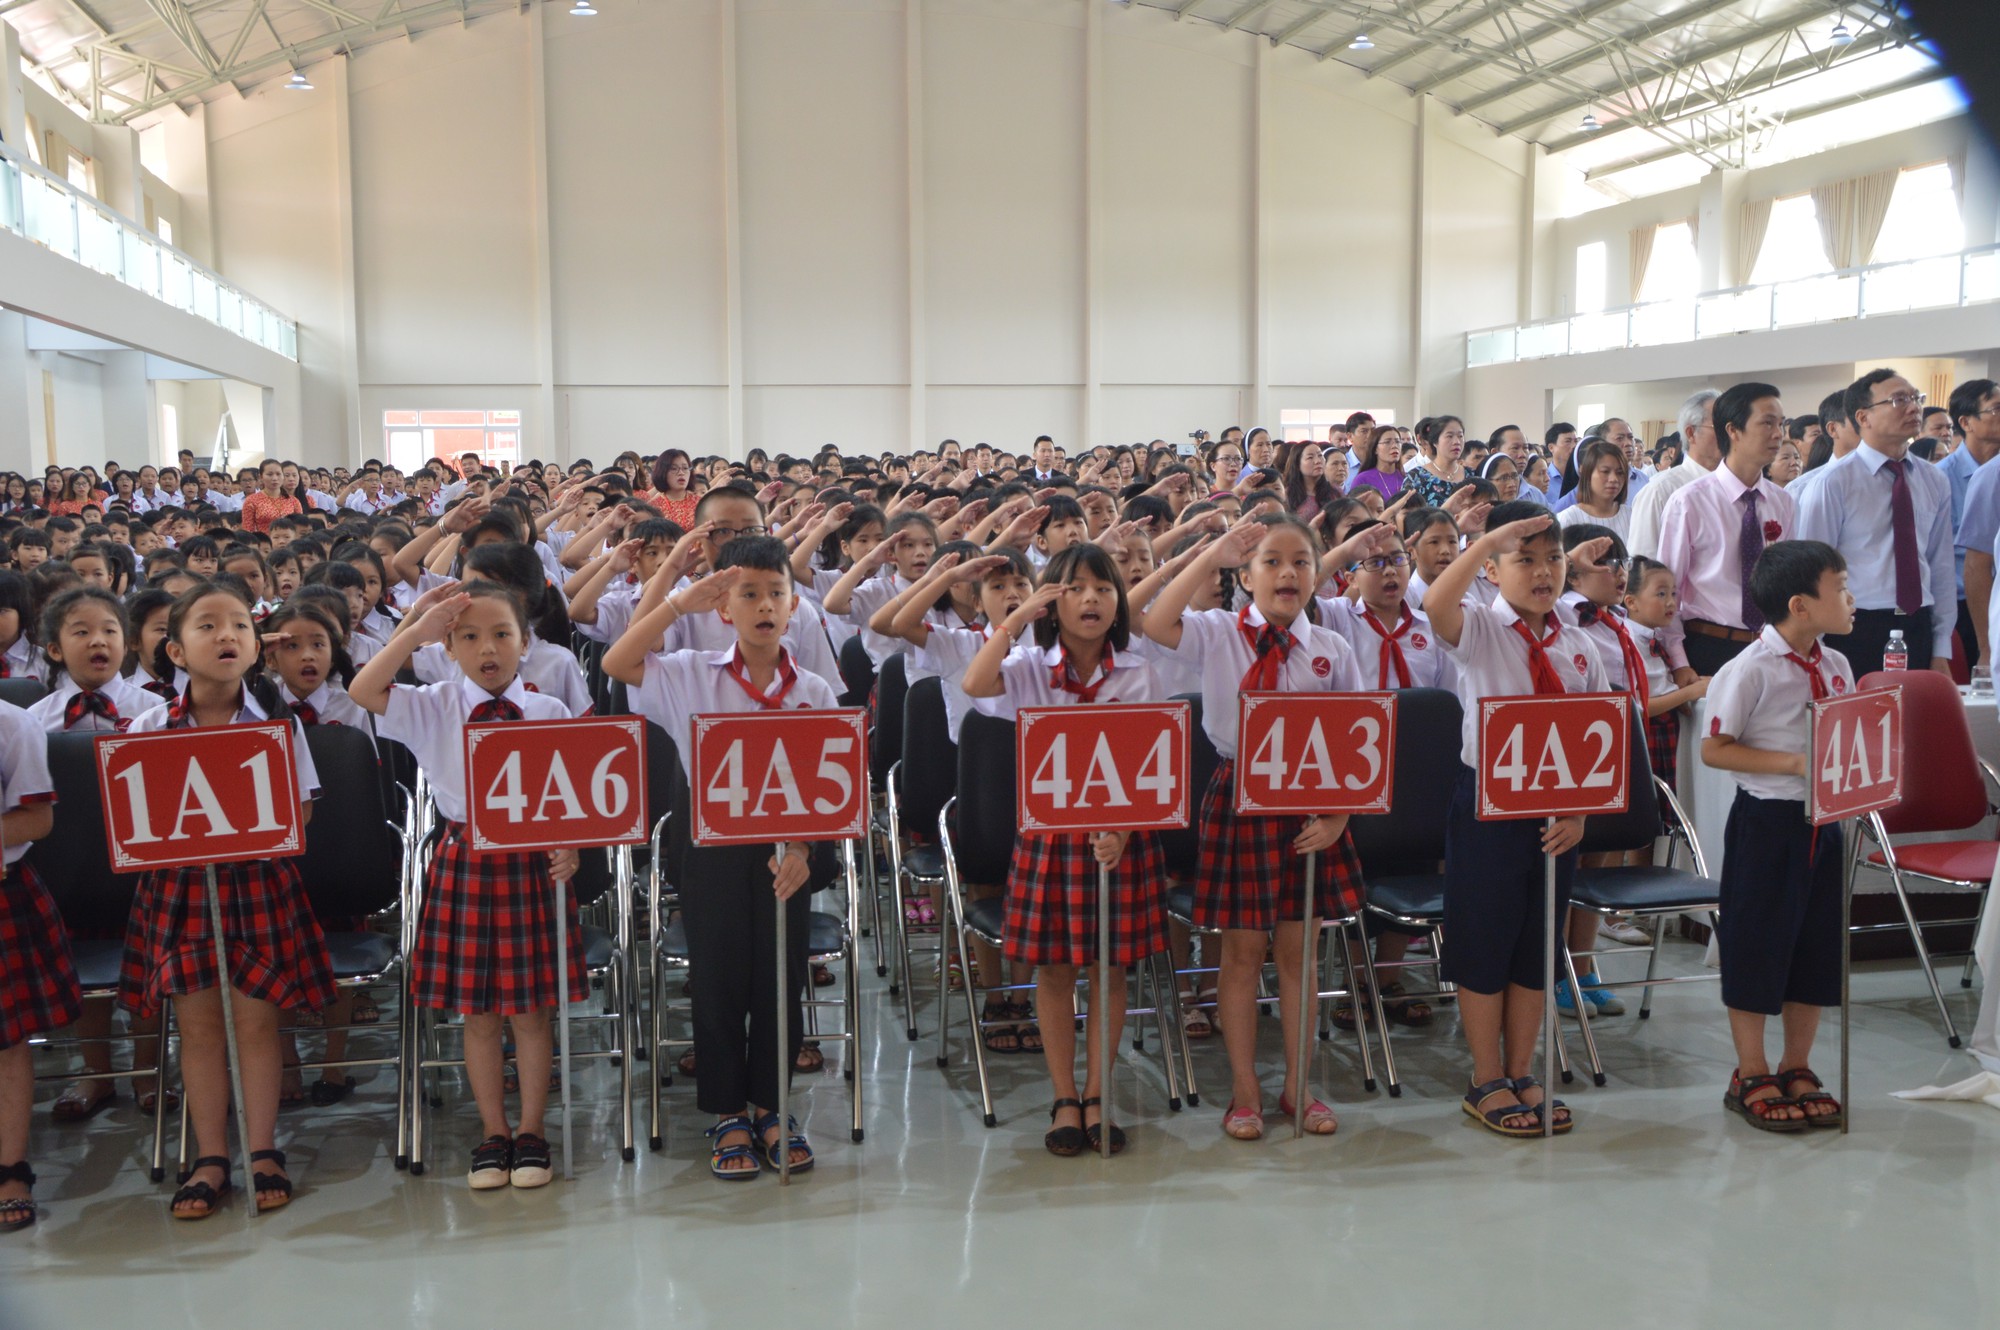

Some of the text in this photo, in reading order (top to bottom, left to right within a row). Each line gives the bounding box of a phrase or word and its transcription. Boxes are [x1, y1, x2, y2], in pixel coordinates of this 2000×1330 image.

[485, 746, 629, 823] 4A6
[706, 737, 854, 818] 4A5
[1031, 728, 1177, 809] 4A4
[1250, 716, 1382, 791] 4A3
[1492, 719, 1616, 792] 4A2
[1821, 710, 1895, 795] 4A1
[114, 749, 287, 845] 1A1
